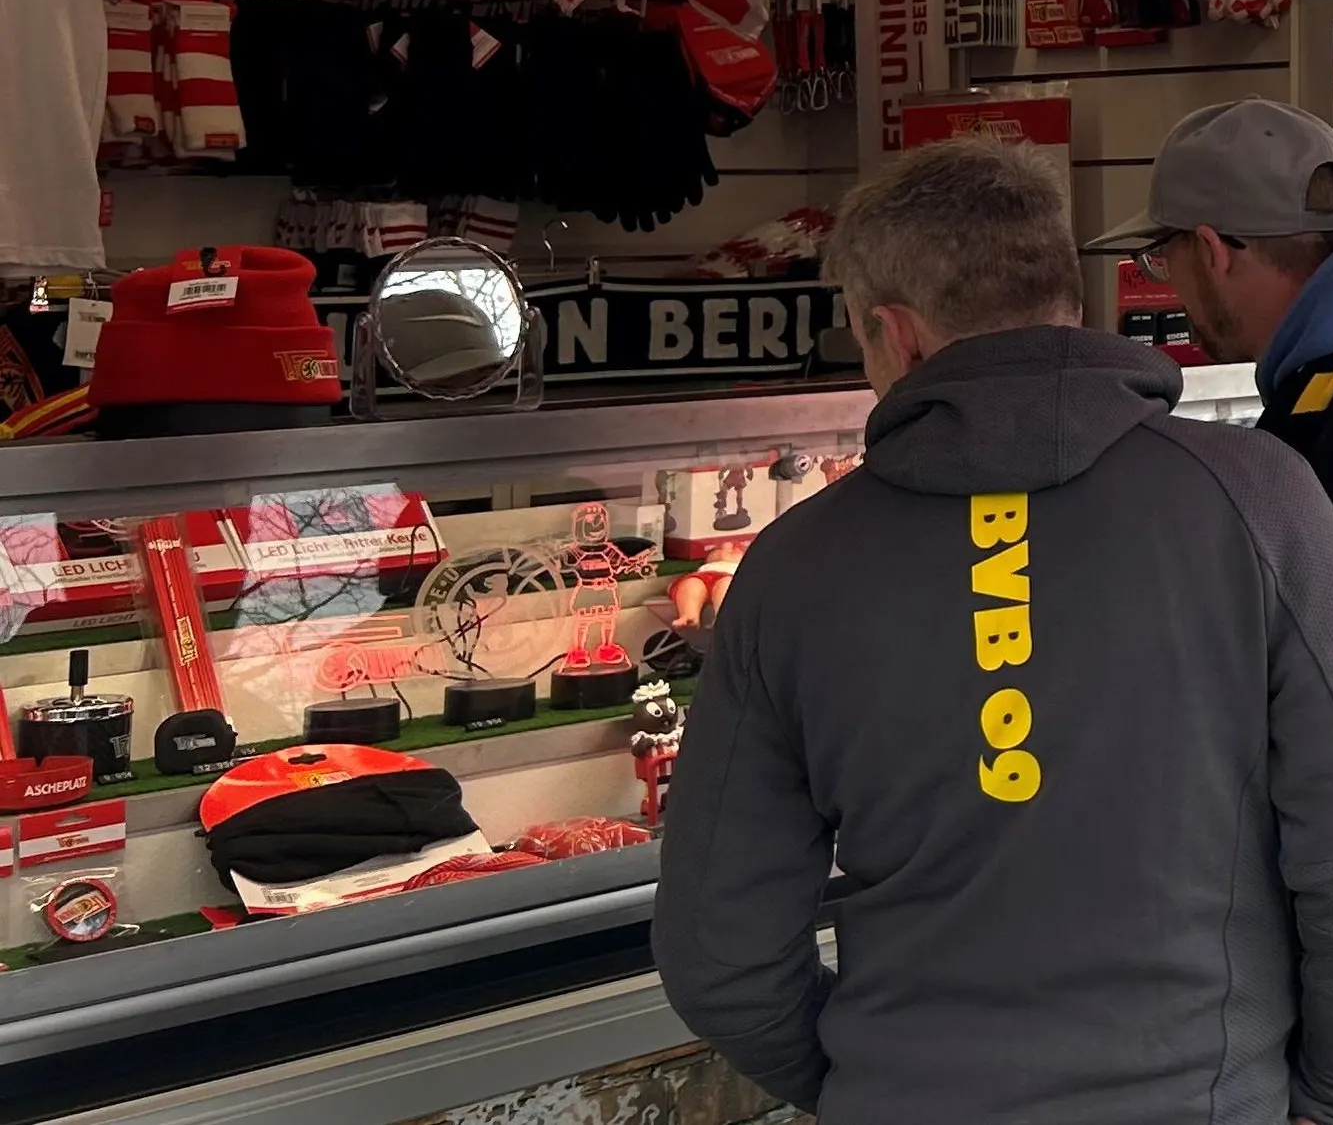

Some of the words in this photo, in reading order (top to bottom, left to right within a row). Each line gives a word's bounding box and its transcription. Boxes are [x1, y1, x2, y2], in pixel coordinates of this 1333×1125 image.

[970, 493, 1034, 674] BVB
[24, 775, 88, 797] ASCHEPLATZ
[978, 687, 1043, 804] 09
